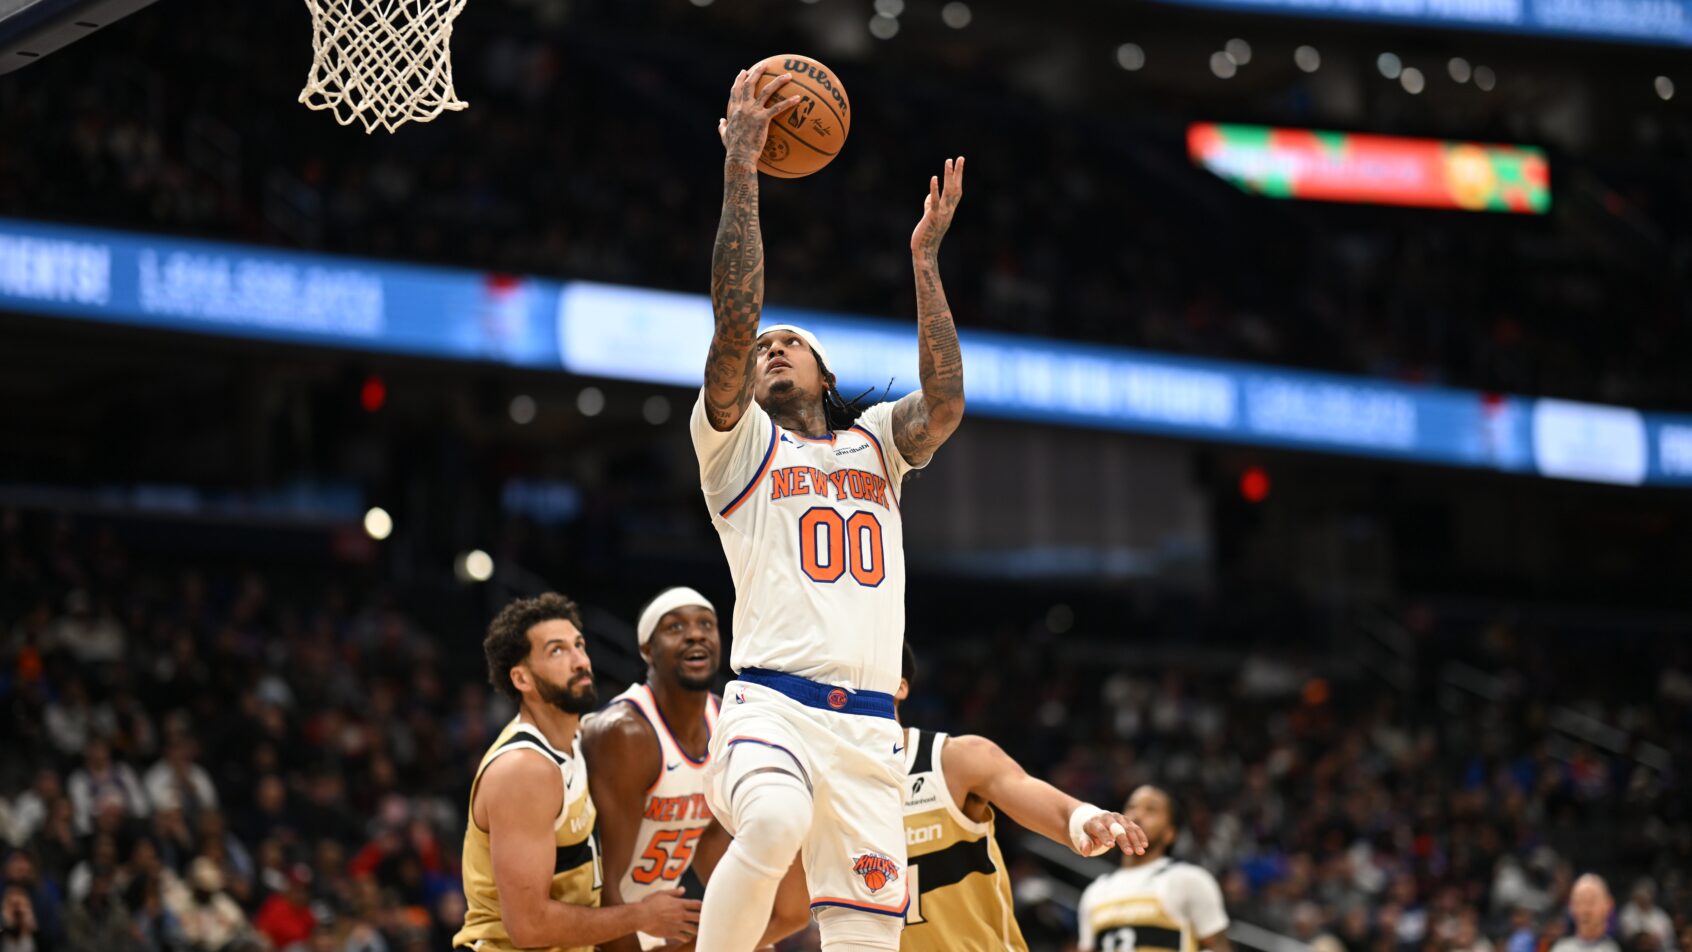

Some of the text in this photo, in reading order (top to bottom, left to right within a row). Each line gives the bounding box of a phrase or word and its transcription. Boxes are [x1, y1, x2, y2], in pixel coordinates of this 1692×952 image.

[783, 58, 848, 117] Wilson
[770, 465, 890, 511] NEW YORK
[799, 506, 885, 587] 00
[631, 827, 705, 884] 55
[852, 854, 899, 881] KNICKS
